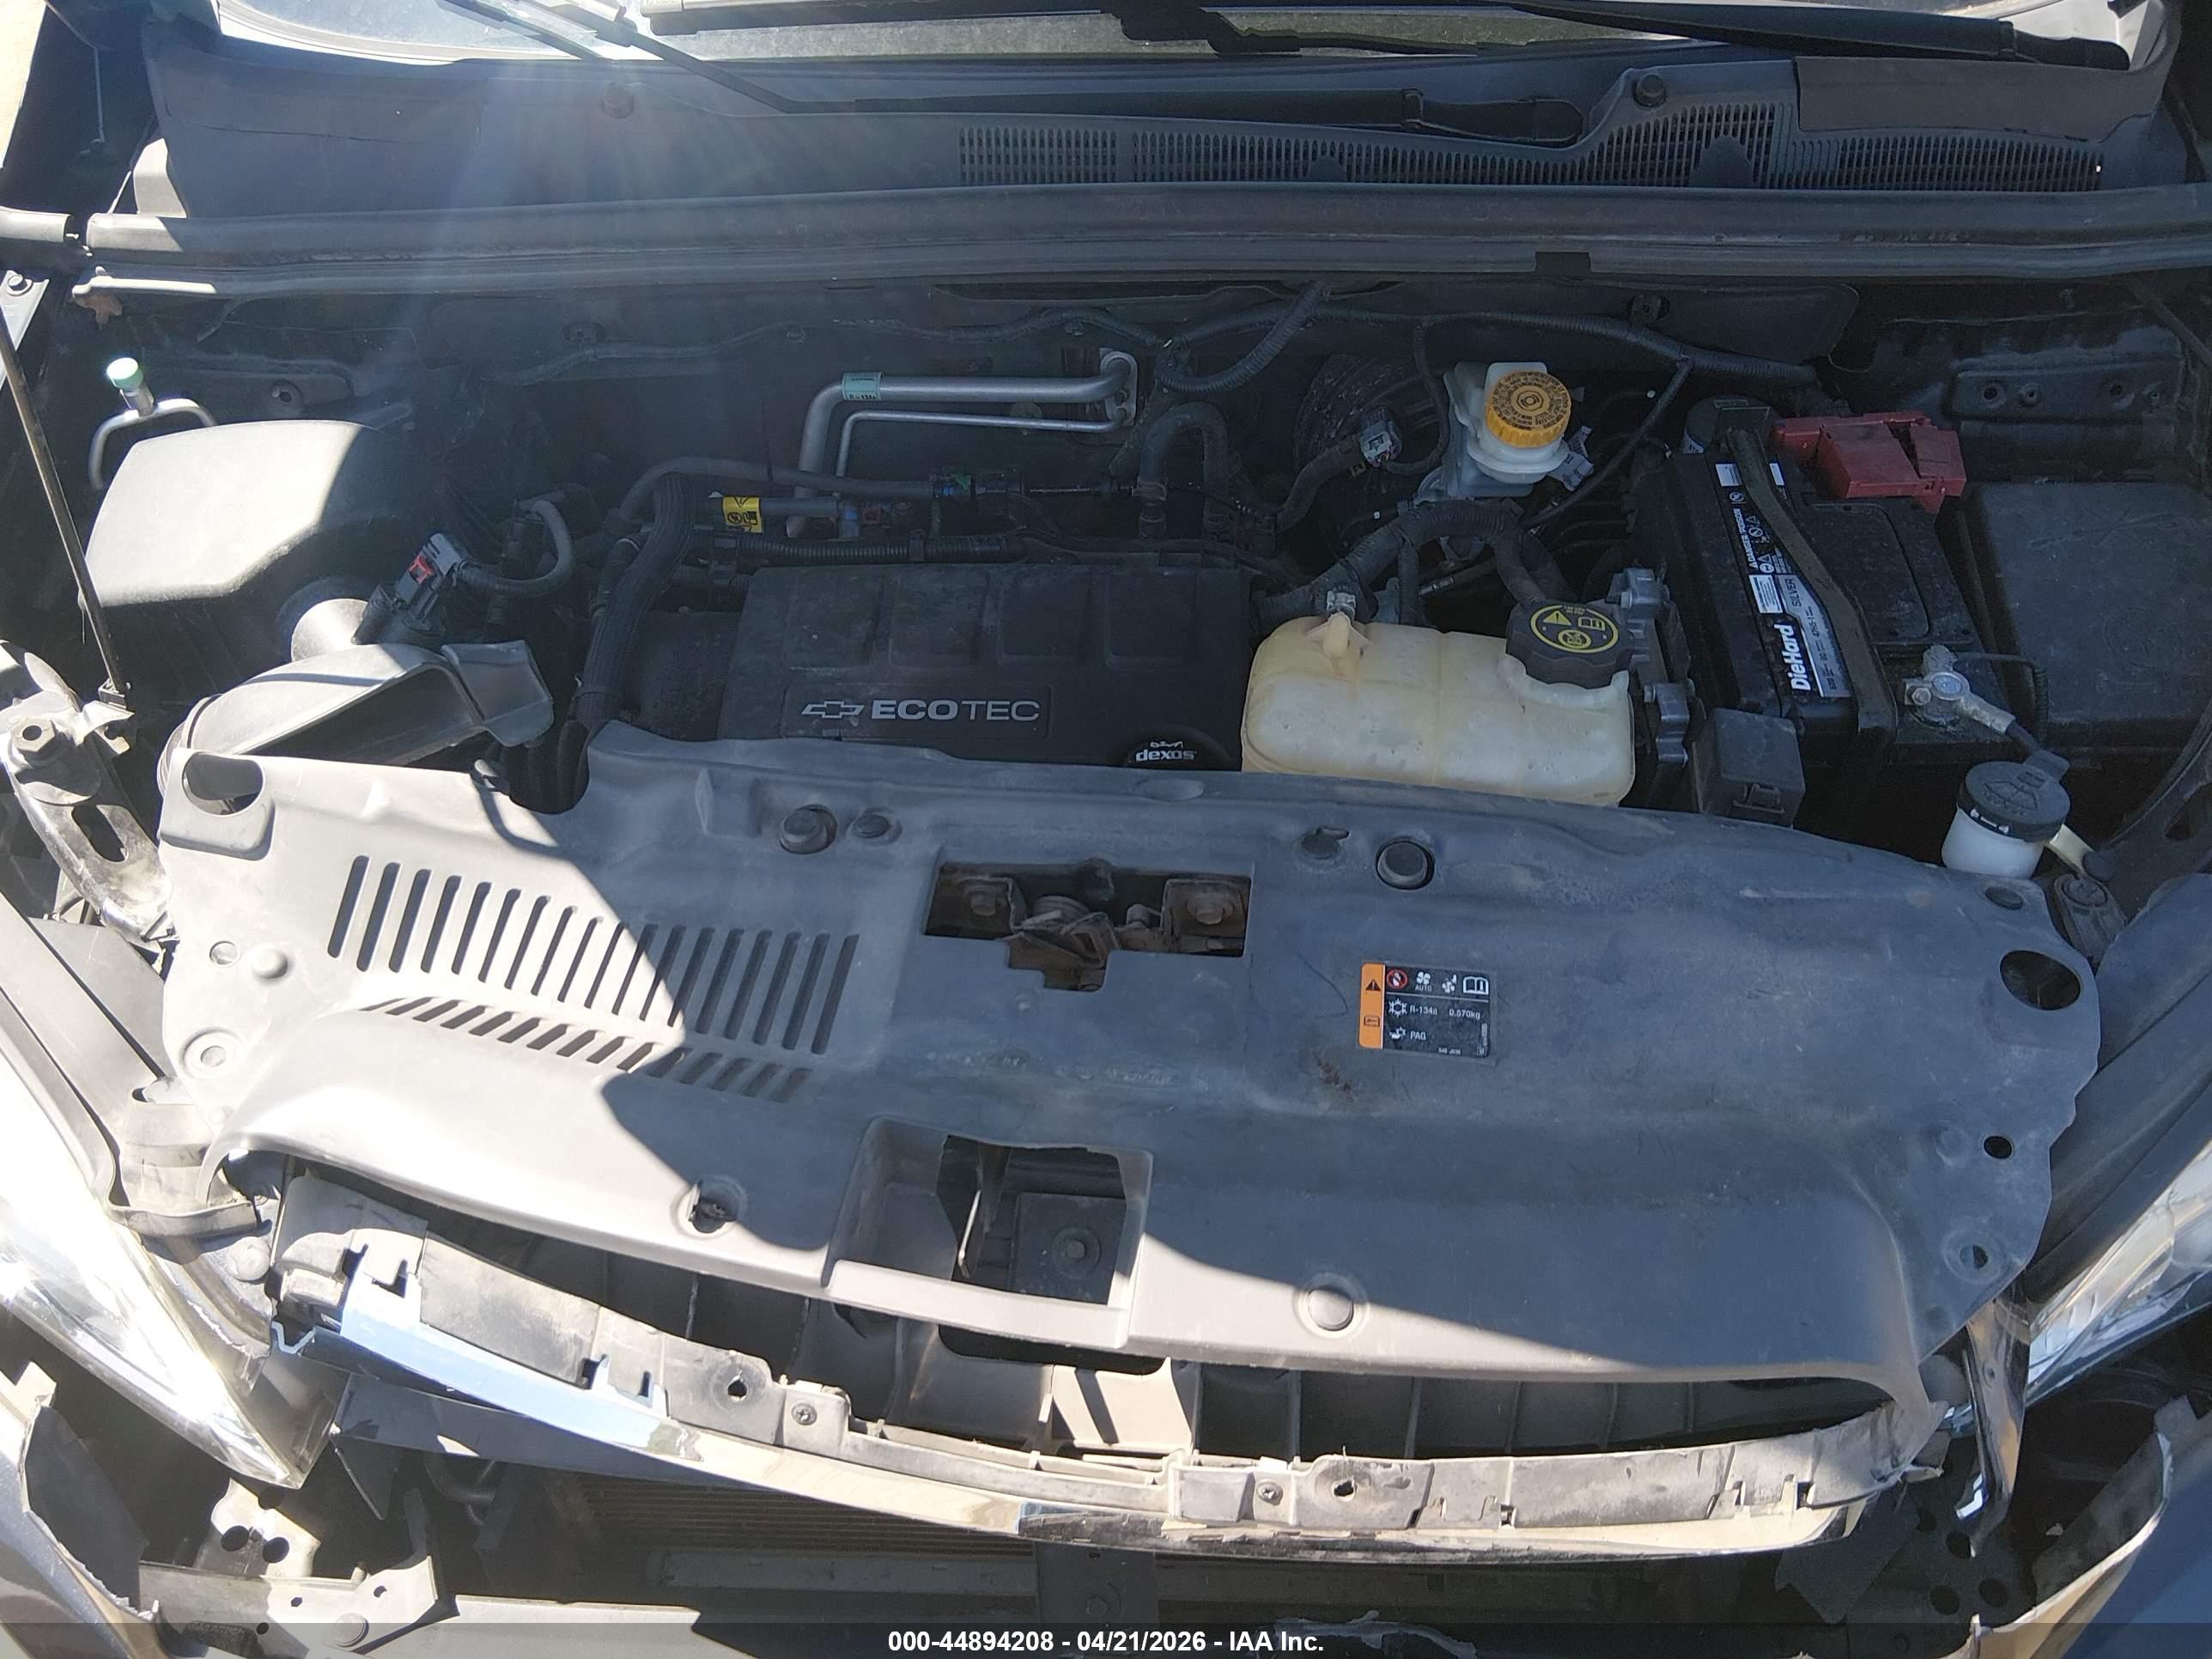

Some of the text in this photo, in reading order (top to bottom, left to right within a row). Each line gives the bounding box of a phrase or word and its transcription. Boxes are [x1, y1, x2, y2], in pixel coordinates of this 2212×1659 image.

[1784, 577, 1802, 608] SILVER
[1772, 623, 1812, 691] DieHard
[871, 699, 1041, 721] ECOTEC
[1135, 748, 1195, 763] dexos
[1414, 984, 1432, 993] AUTO
[1409, 1005, 1438, 1016] R-134a
[1409, 1030, 1427, 1041] PAG
